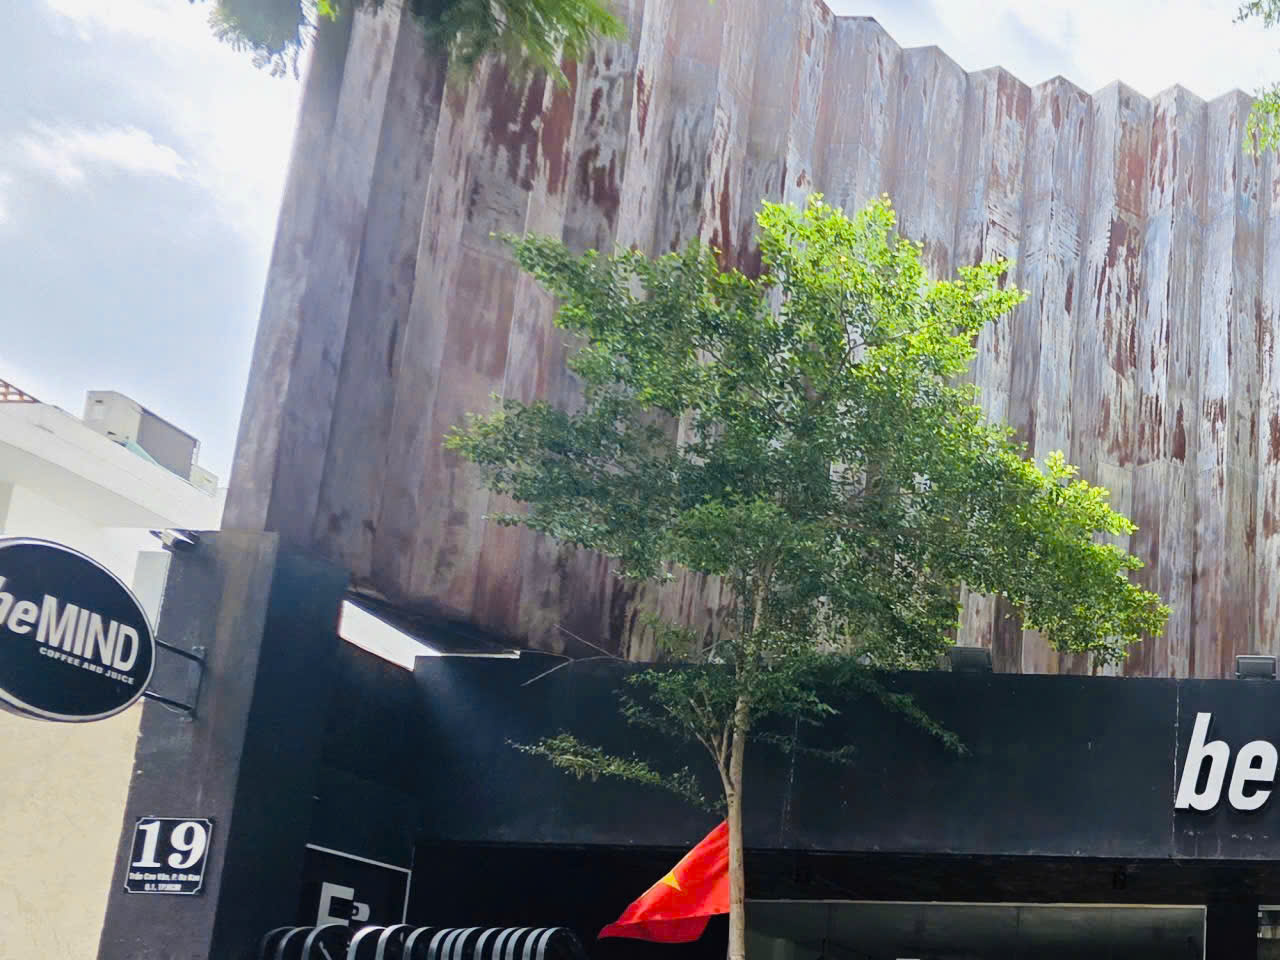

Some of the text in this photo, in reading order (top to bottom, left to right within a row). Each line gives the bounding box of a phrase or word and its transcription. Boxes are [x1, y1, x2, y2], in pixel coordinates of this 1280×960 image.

[39, 647, 134, 685] COFFEE AND JUICE
[132, 820, 207, 869] 19
